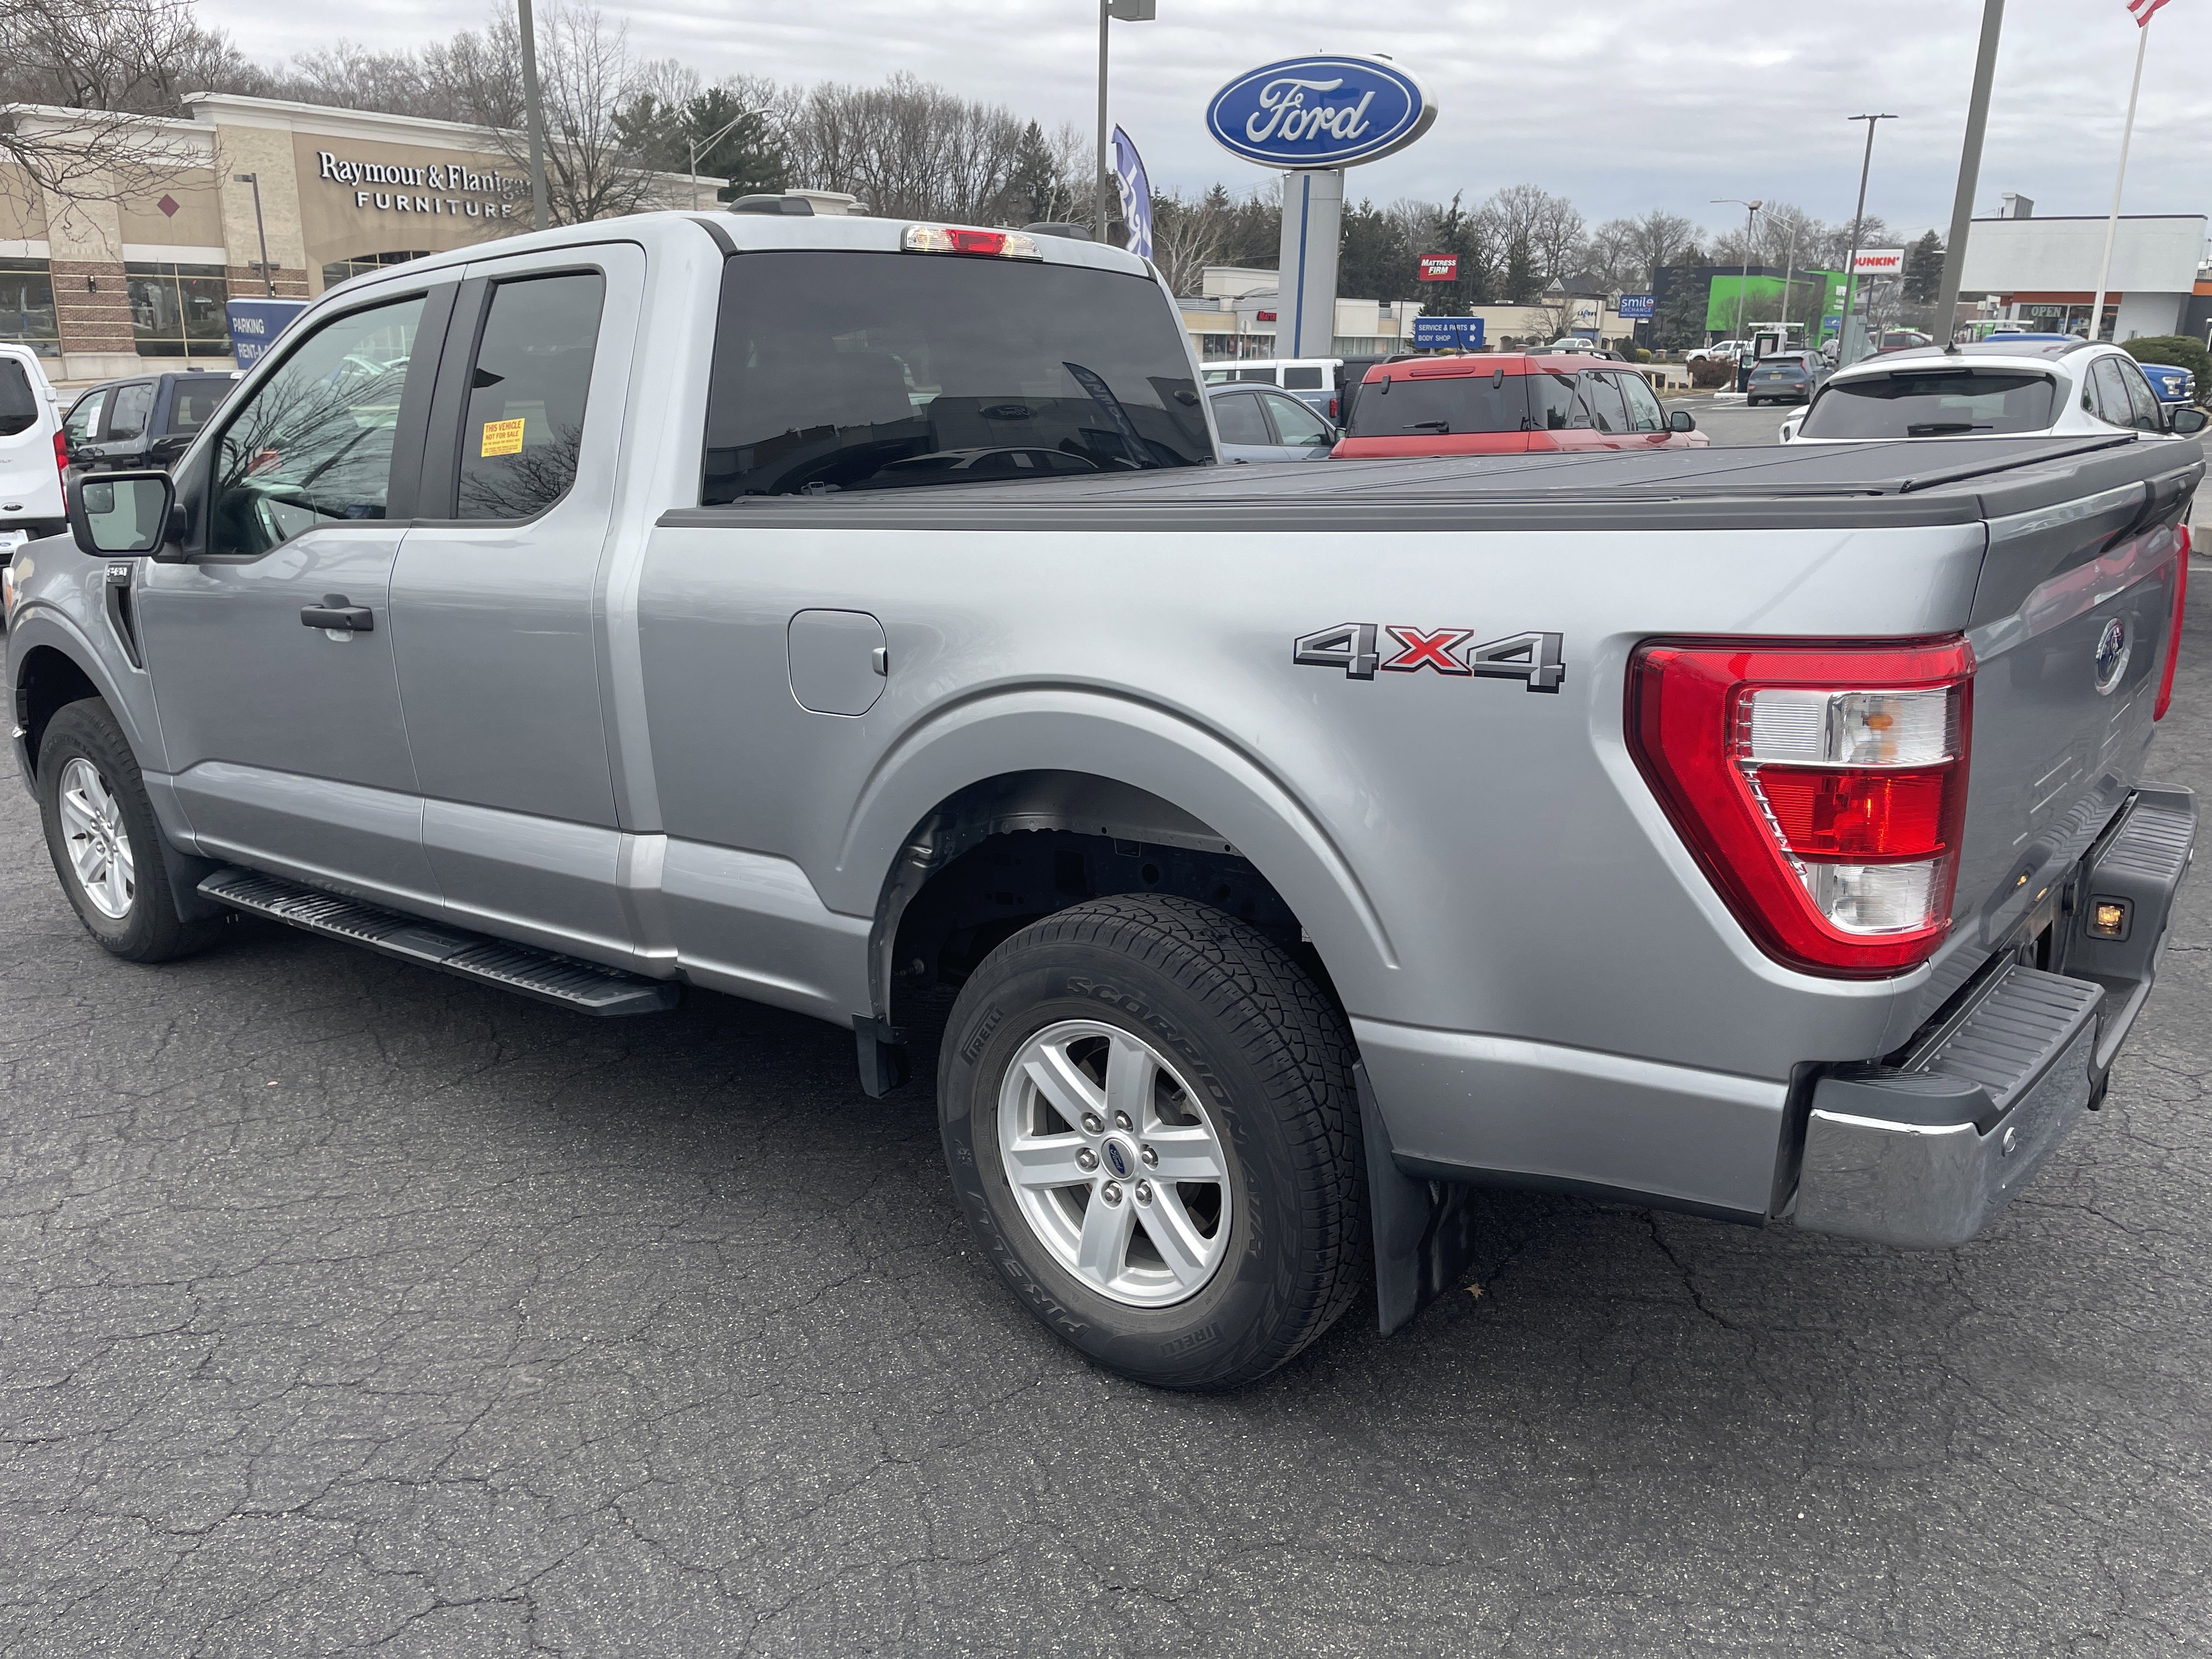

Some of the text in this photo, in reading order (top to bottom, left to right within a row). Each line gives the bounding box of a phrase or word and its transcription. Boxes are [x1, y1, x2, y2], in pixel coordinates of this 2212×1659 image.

[1246, 78, 1375, 143] Ford
[317, 151, 532, 201] Raymour & Flaniga
[355, 191, 512, 218] FURNITURE
[232, 318, 264, 334] PARKING
[1621, 296, 1654, 308] smile
[2031, 306, 2062, 318] OPEN
[486, 420, 521, 433] THIS VEHICLE
[1293, 622, 1566, 694] 4X4
[960, 1001, 1005, 1066] PIRELLI
[1068, 977, 1250, 1144] SCORPION
[1241, 1157, 1265, 1260] ATR
[967, 1191, 1091, 1341] PIRELLI
[1159, 1321, 1224, 1361] PIRELLI
